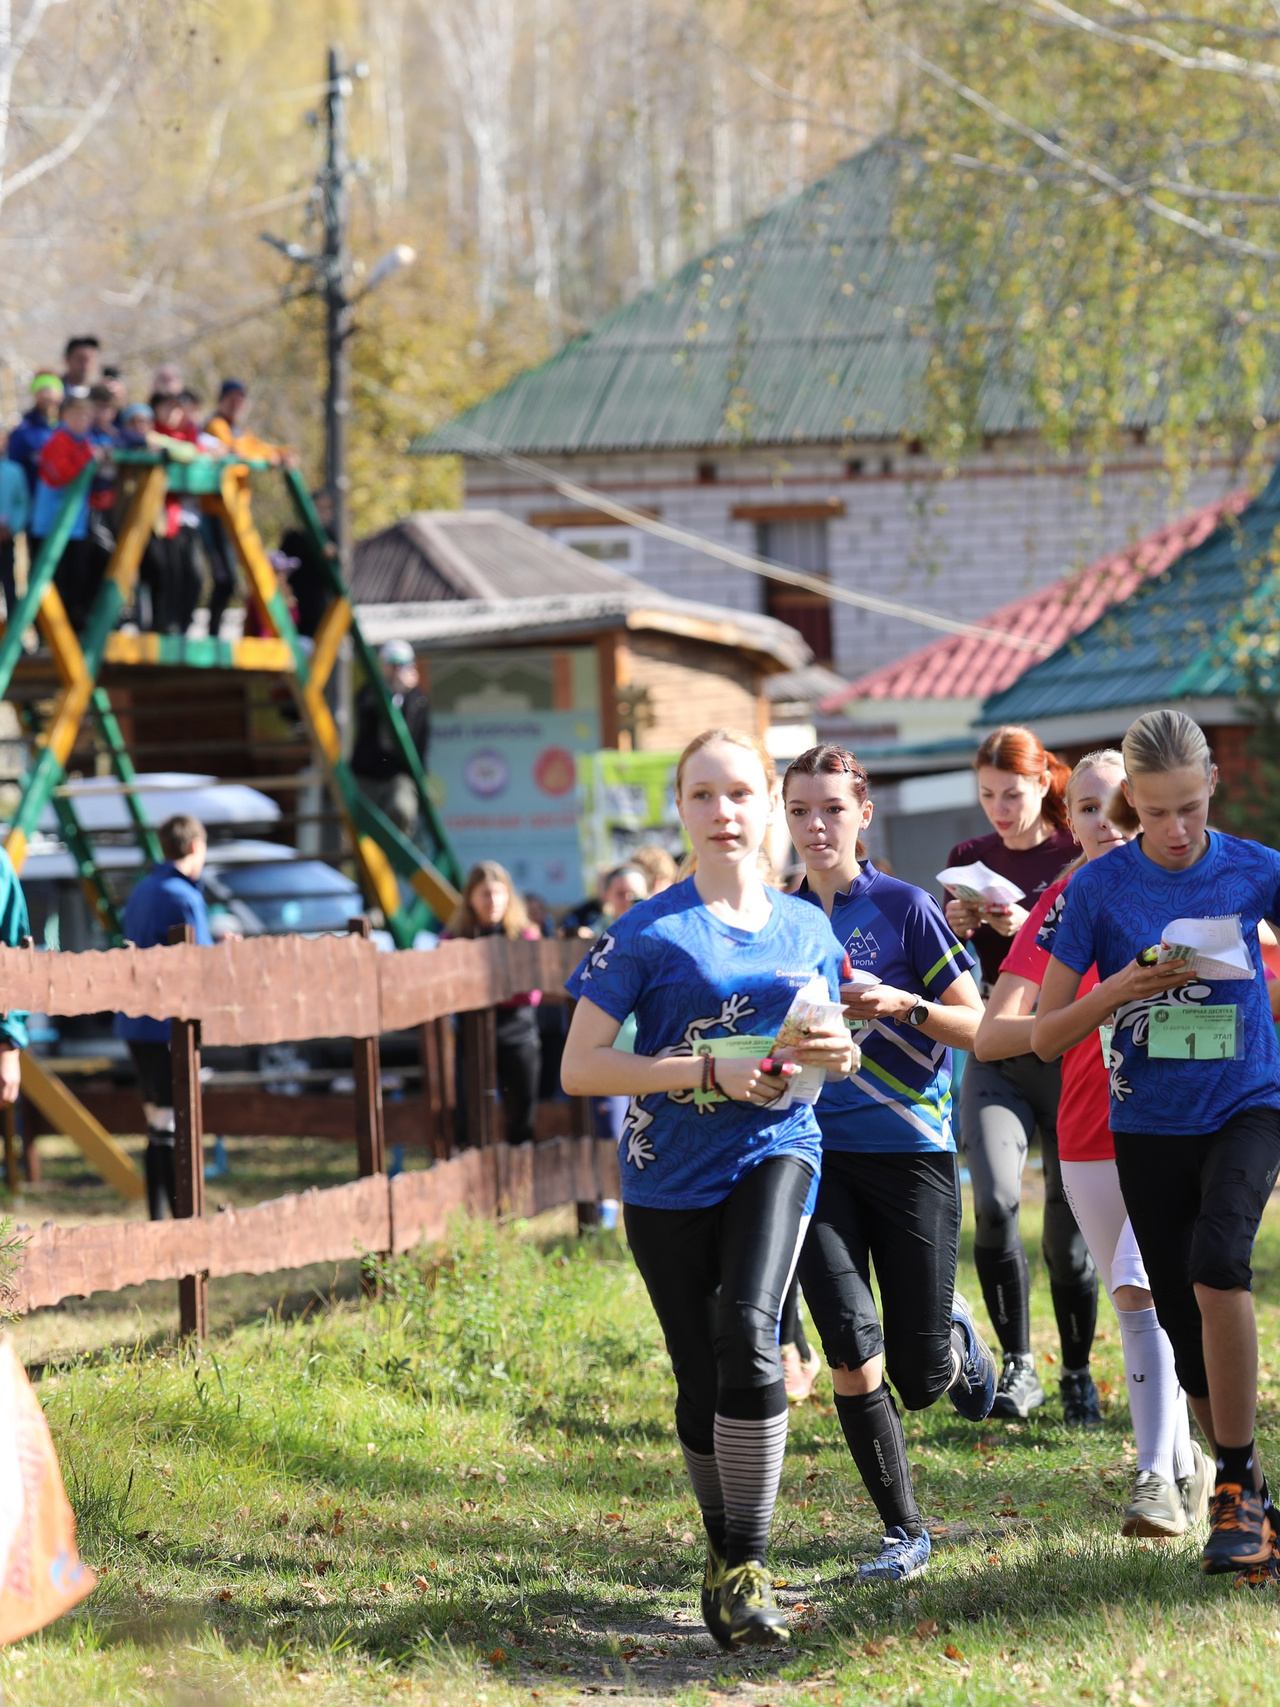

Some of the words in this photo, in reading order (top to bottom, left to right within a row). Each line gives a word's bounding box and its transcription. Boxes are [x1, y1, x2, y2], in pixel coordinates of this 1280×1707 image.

[1185, 1033, 1196, 1059] 1
[1220, 1041, 1226, 1058] 1
[873, 1439, 888, 1474] NORD
